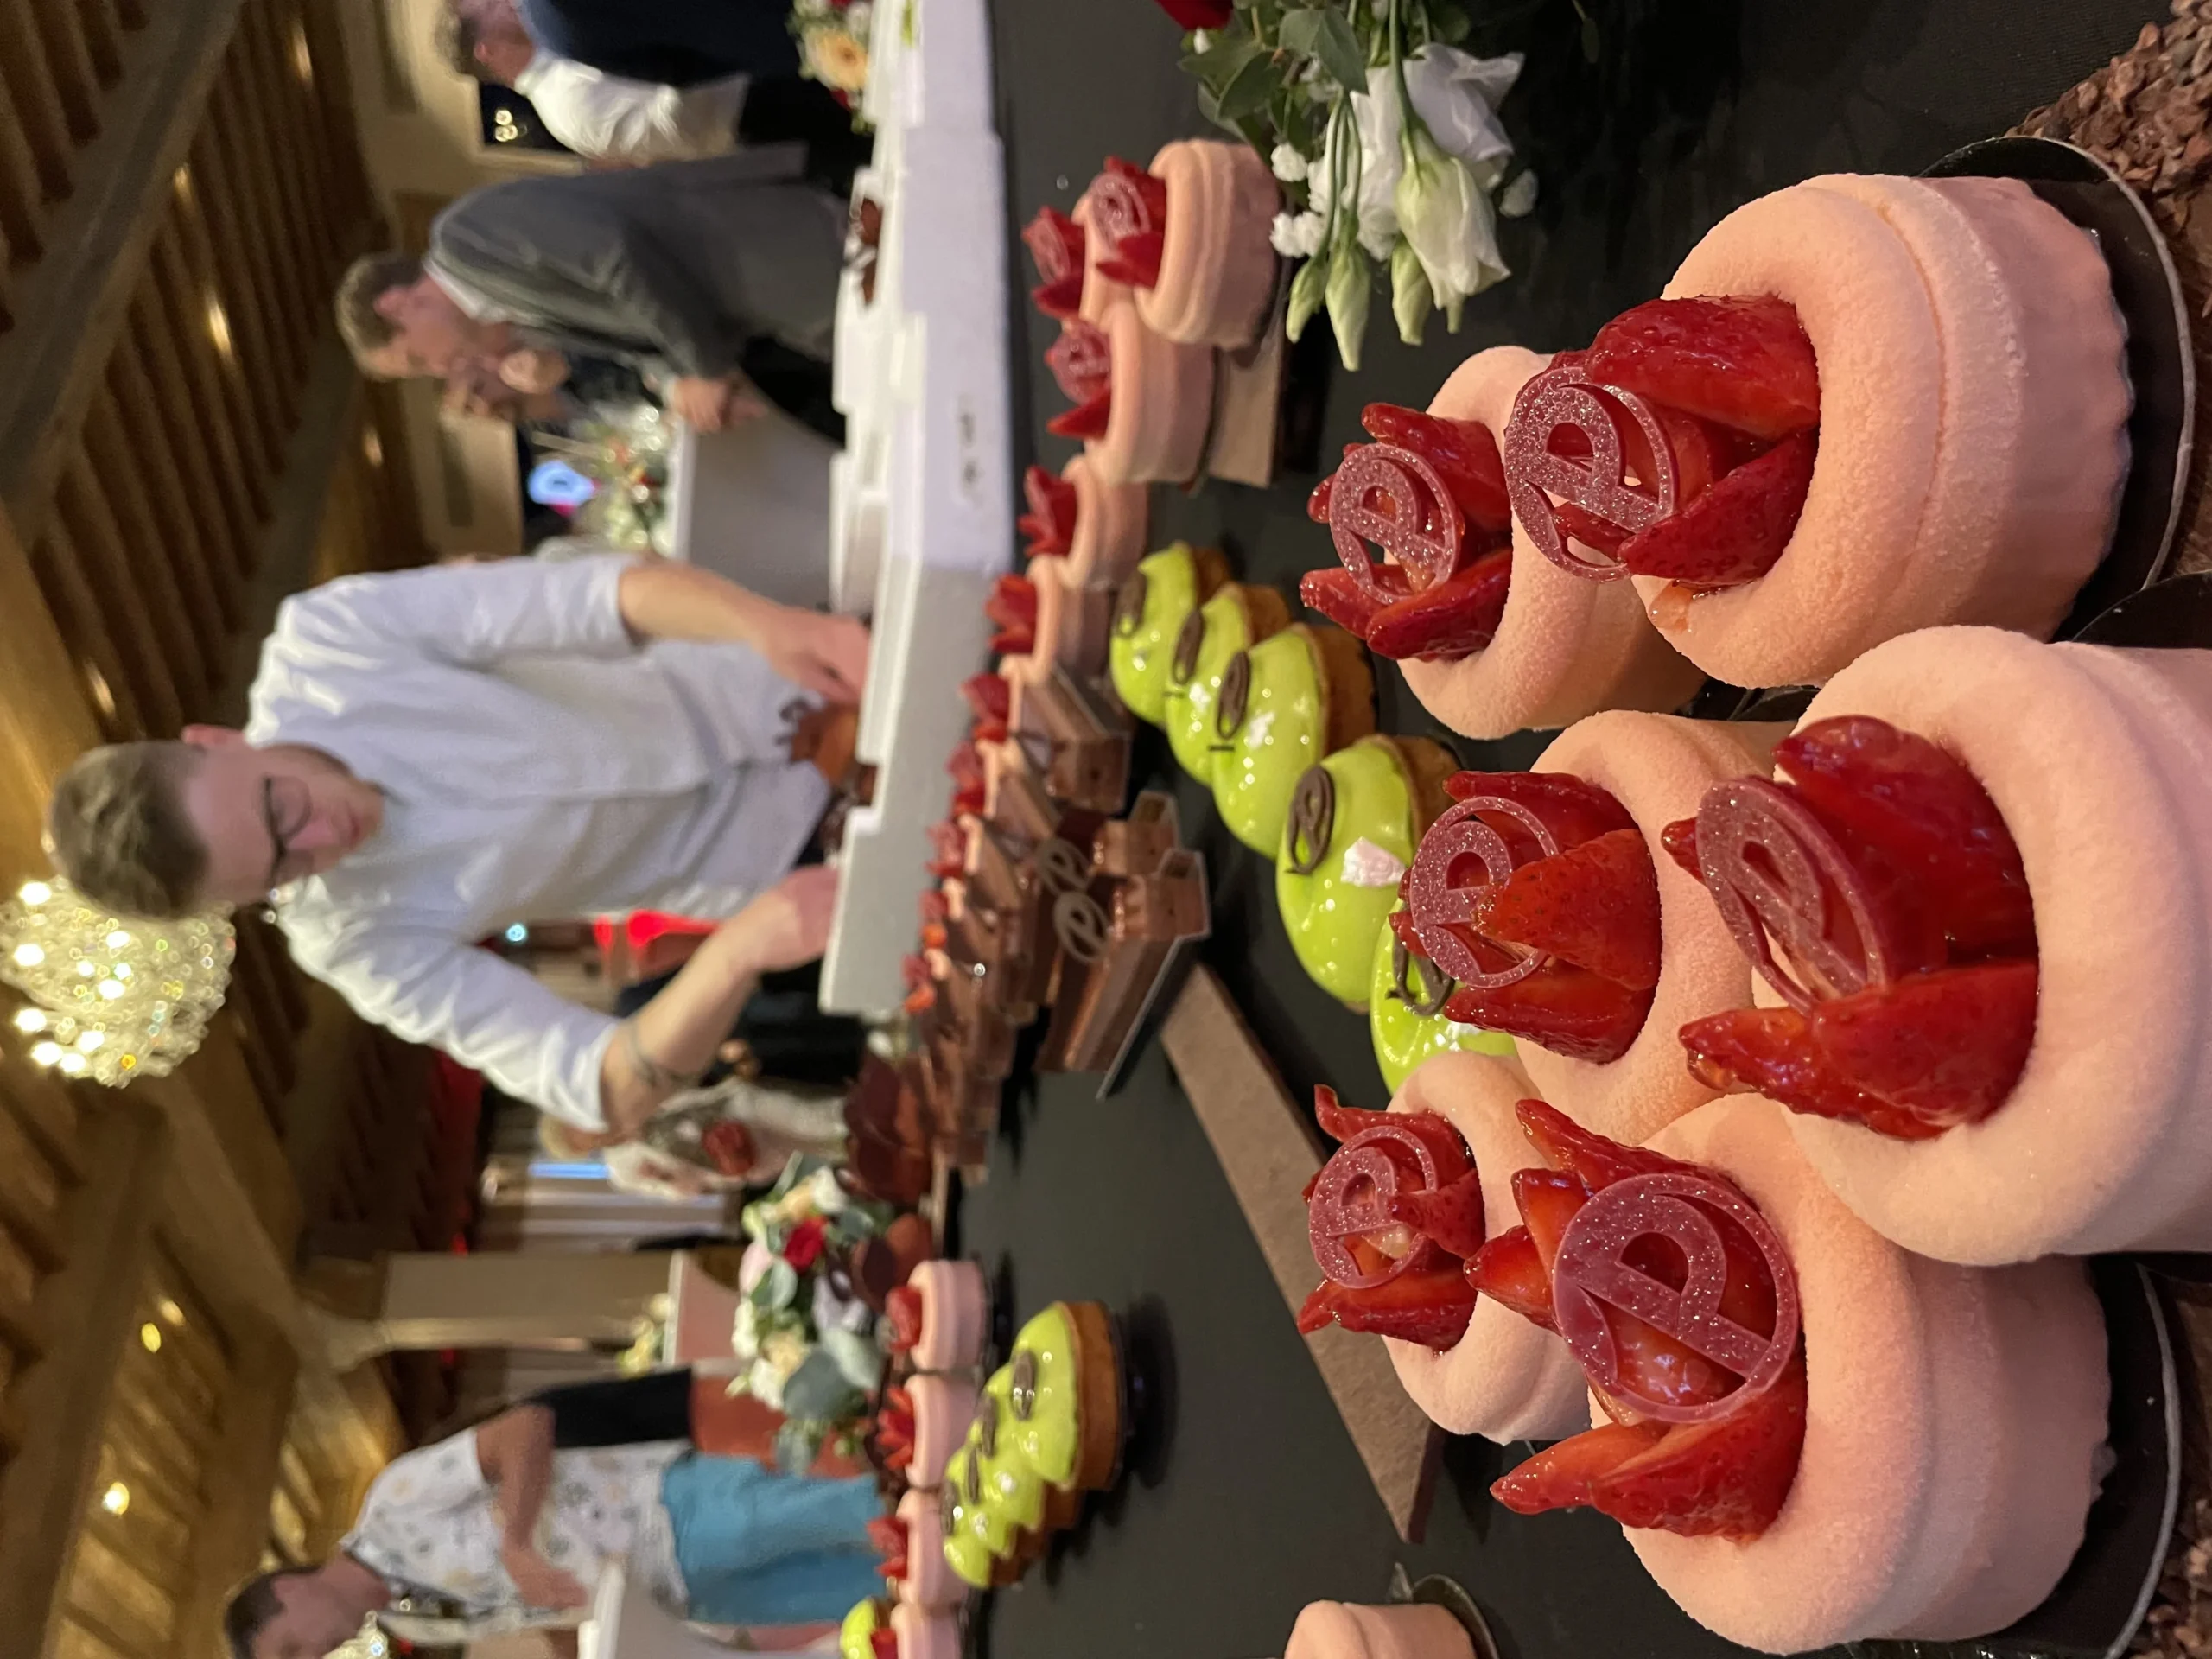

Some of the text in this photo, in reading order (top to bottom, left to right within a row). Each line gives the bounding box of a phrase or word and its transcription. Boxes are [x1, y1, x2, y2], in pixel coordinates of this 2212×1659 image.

[1329, 442, 1460, 604] P
[1505, 366, 1678, 580] P
[1694, 779, 1886, 1018] P
[1553, 1173, 1799, 1423] P
